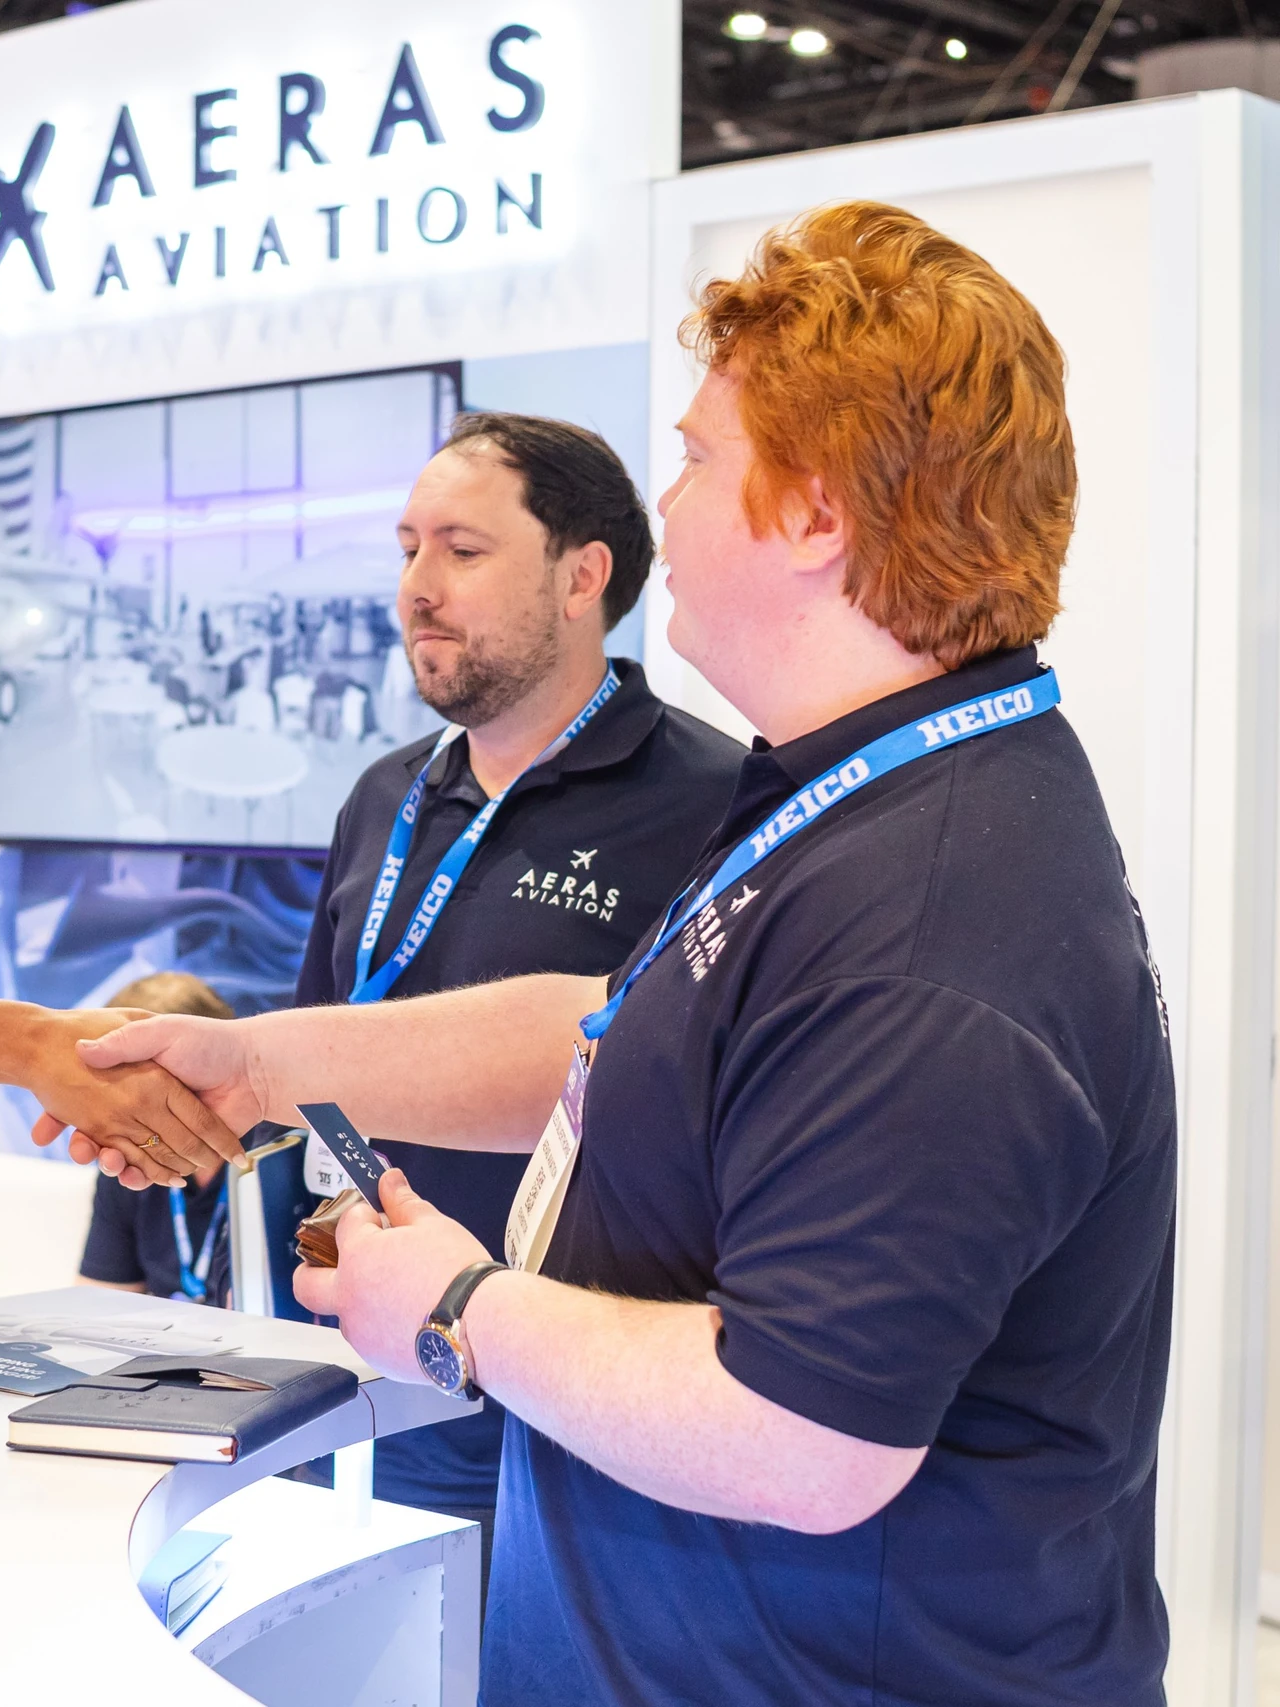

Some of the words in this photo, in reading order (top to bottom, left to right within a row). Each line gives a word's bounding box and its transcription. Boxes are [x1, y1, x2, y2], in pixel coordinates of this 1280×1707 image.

[92, 23, 546, 207] AERAS
[95, 172, 543, 297] AVIATION
[916, 687, 1033, 747] HEICO
[749, 757, 870, 859] HEICO
[361, 853, 404, 950] HEICO
[393, 873, 453, 968] HEICO
[511, 886, 613, 922] AVIATION
[517, 868, 620, 908] AERAS
